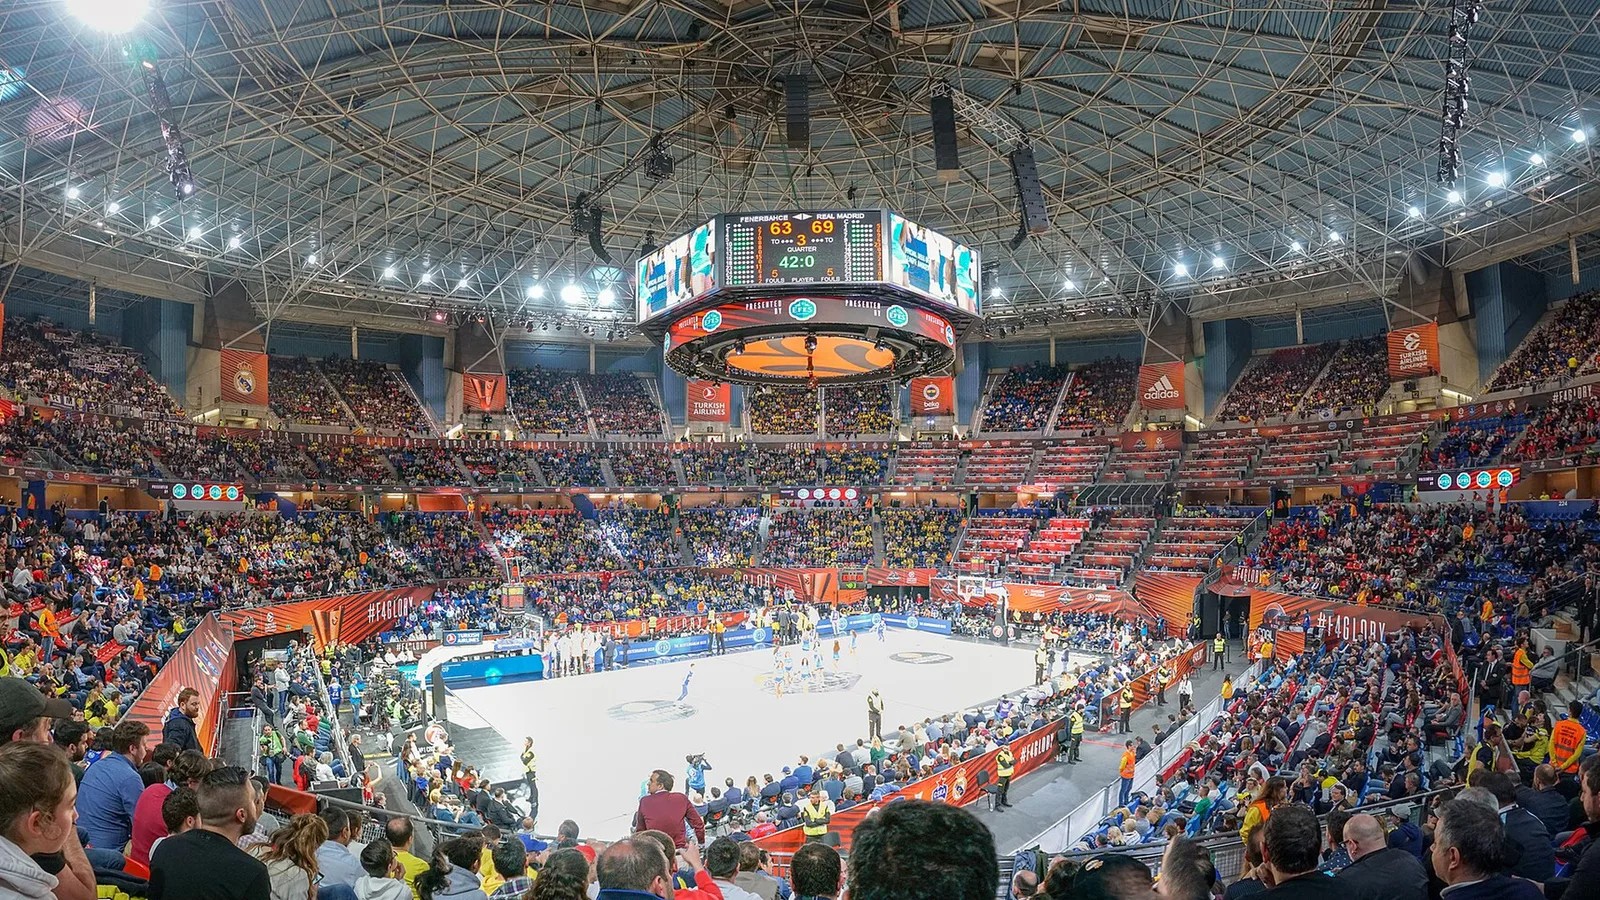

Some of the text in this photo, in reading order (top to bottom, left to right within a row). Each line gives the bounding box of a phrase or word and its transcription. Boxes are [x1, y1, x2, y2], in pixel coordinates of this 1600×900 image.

[770, 221, 792, 235] 63
[811, 220, 834, 234] 69
[796, 234, 806, 246] 3
[779, 256, 815, 268] 42:0
[772, 270, 778, 278] 5
[827, 268, 834, 276] 5
[745, 300, 782, 310] PRESENTED
[845, 300, 880, 310] PRESENTED
[1400, 350, 1427, 359] TURKISH
[1400, 355, 1428, 364] AIRLINES
[1144, 390, 1179, 400] adidas
[301, 433, 354, 444] TURKISH
[523, 441, 558, 450] FINAL
